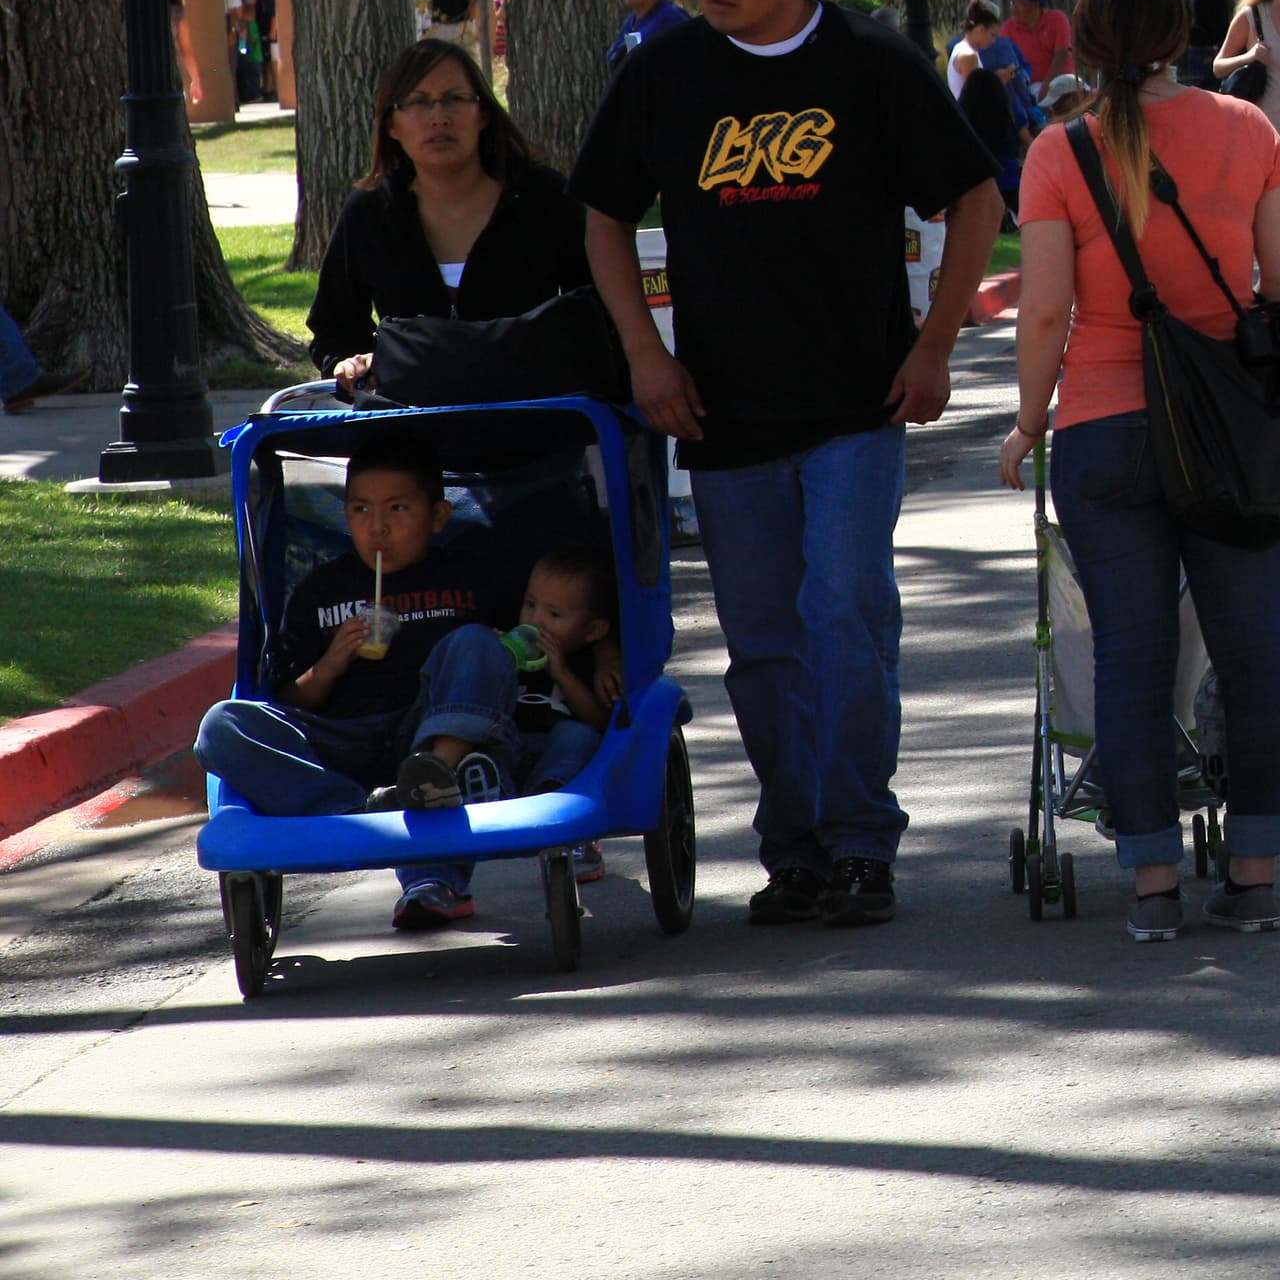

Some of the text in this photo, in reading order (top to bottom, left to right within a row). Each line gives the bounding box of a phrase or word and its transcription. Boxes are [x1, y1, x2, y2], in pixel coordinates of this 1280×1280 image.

[698, 108, 835, 190] LRG
[642, 272, 669, 295] FAIR
[317, 589, 479, 628] NIKE OOTBALL
[411, 609, 424, 620] NO
[426, 608, 456, 619] LIMITS
